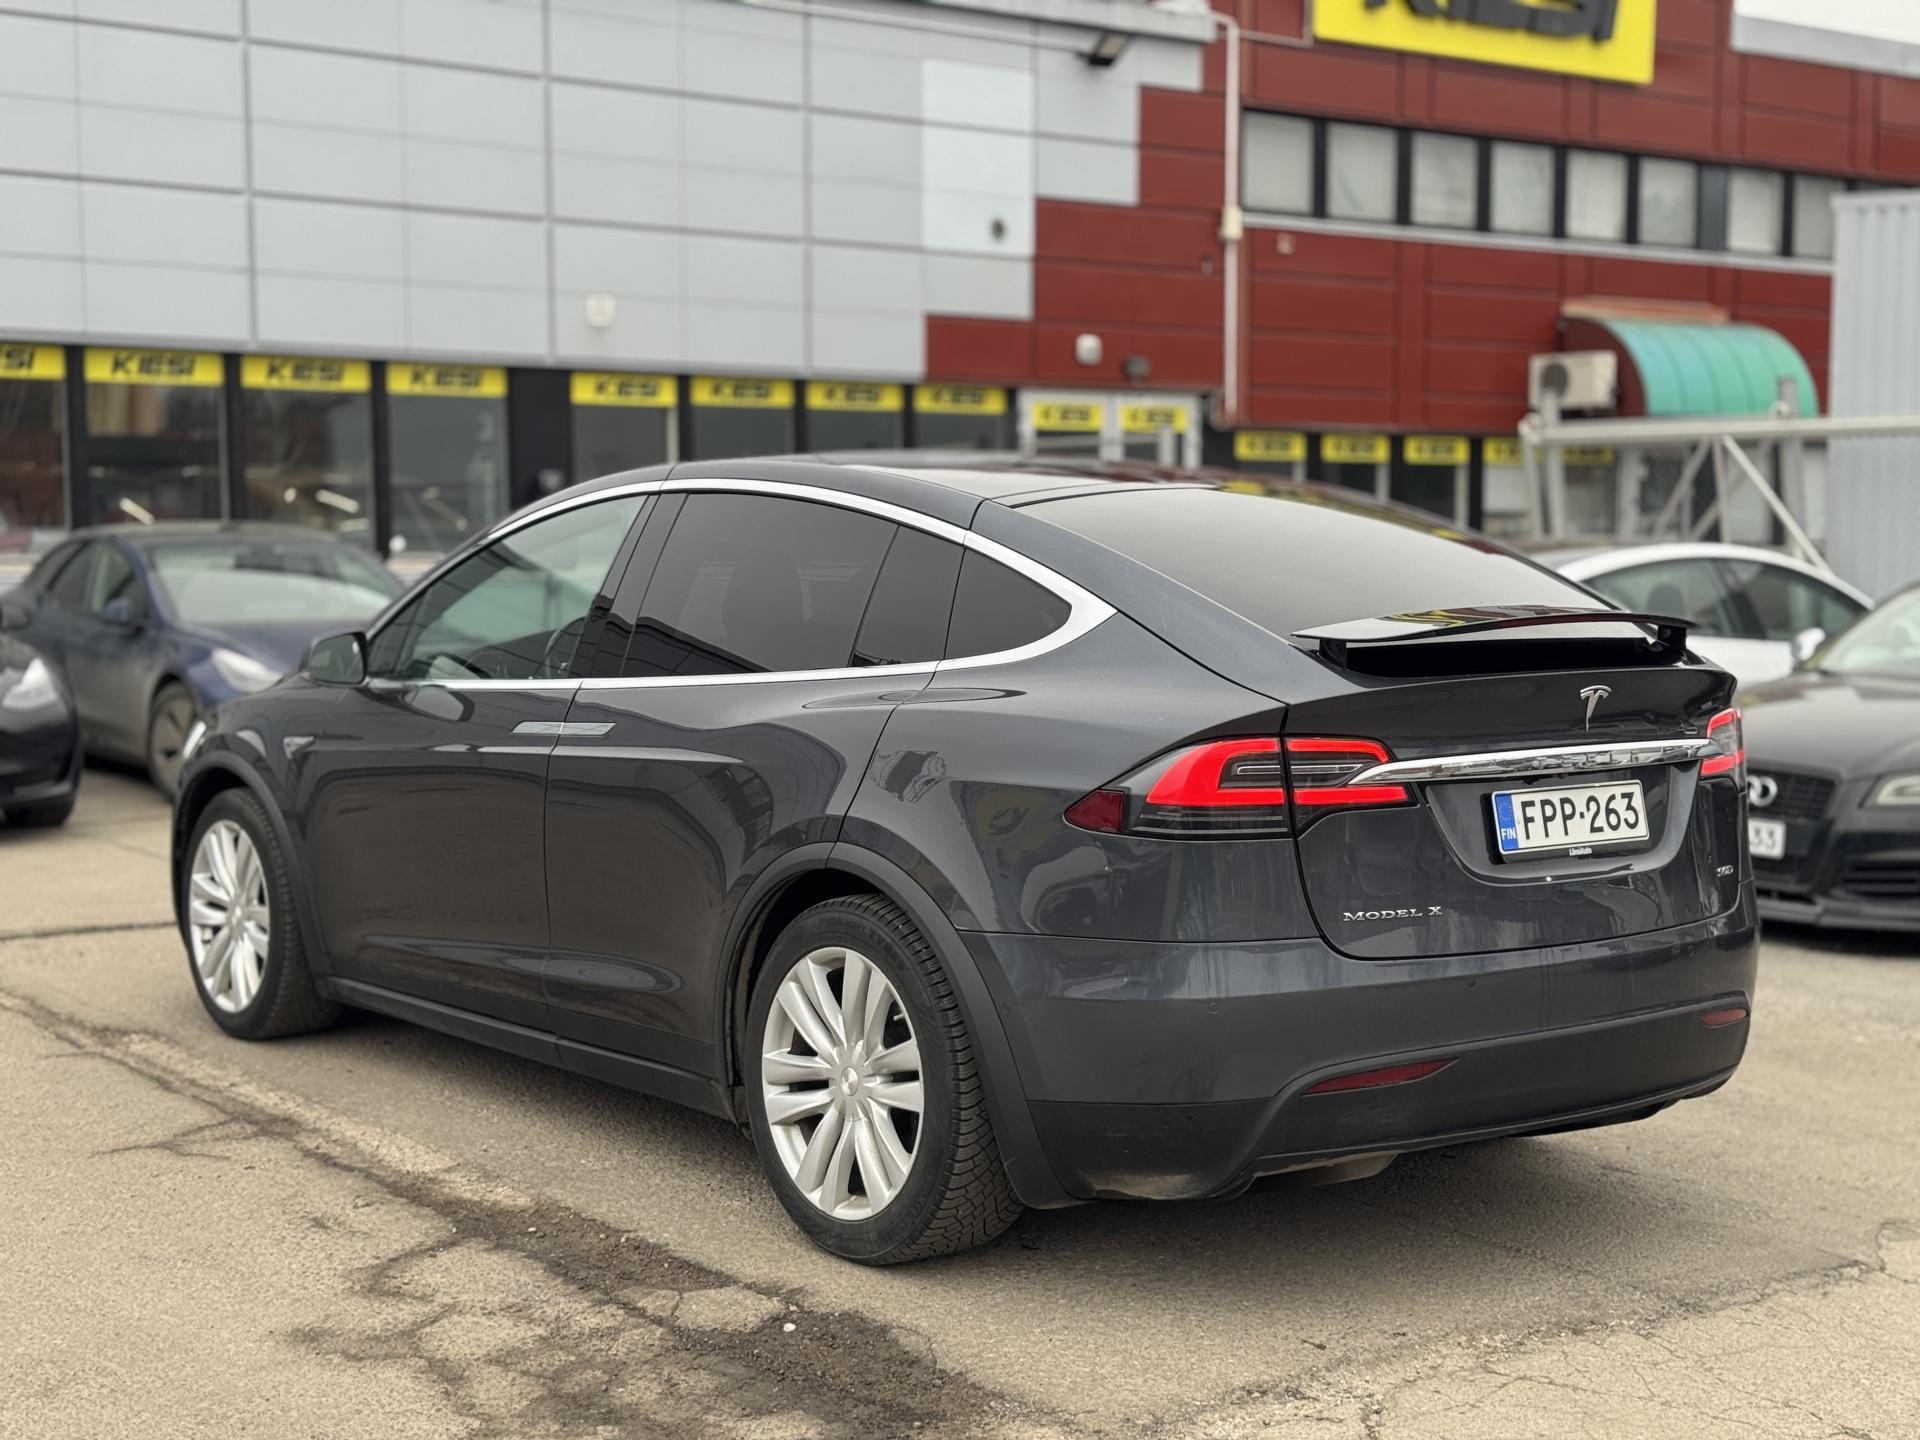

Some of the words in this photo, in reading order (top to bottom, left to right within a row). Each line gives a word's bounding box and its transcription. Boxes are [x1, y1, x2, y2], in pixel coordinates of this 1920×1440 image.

[111, 349, 195, 376] KESI
[266, 359, 343, 382] KESI
[410, 366, 482, 387] KESI
[1520, 791, 1640, 840] FPP-263
[1501, 827, 1517, 841] FIN
[1343, 908, 1423, 921] MODEL
[1428, 906, 1443, 916] X
